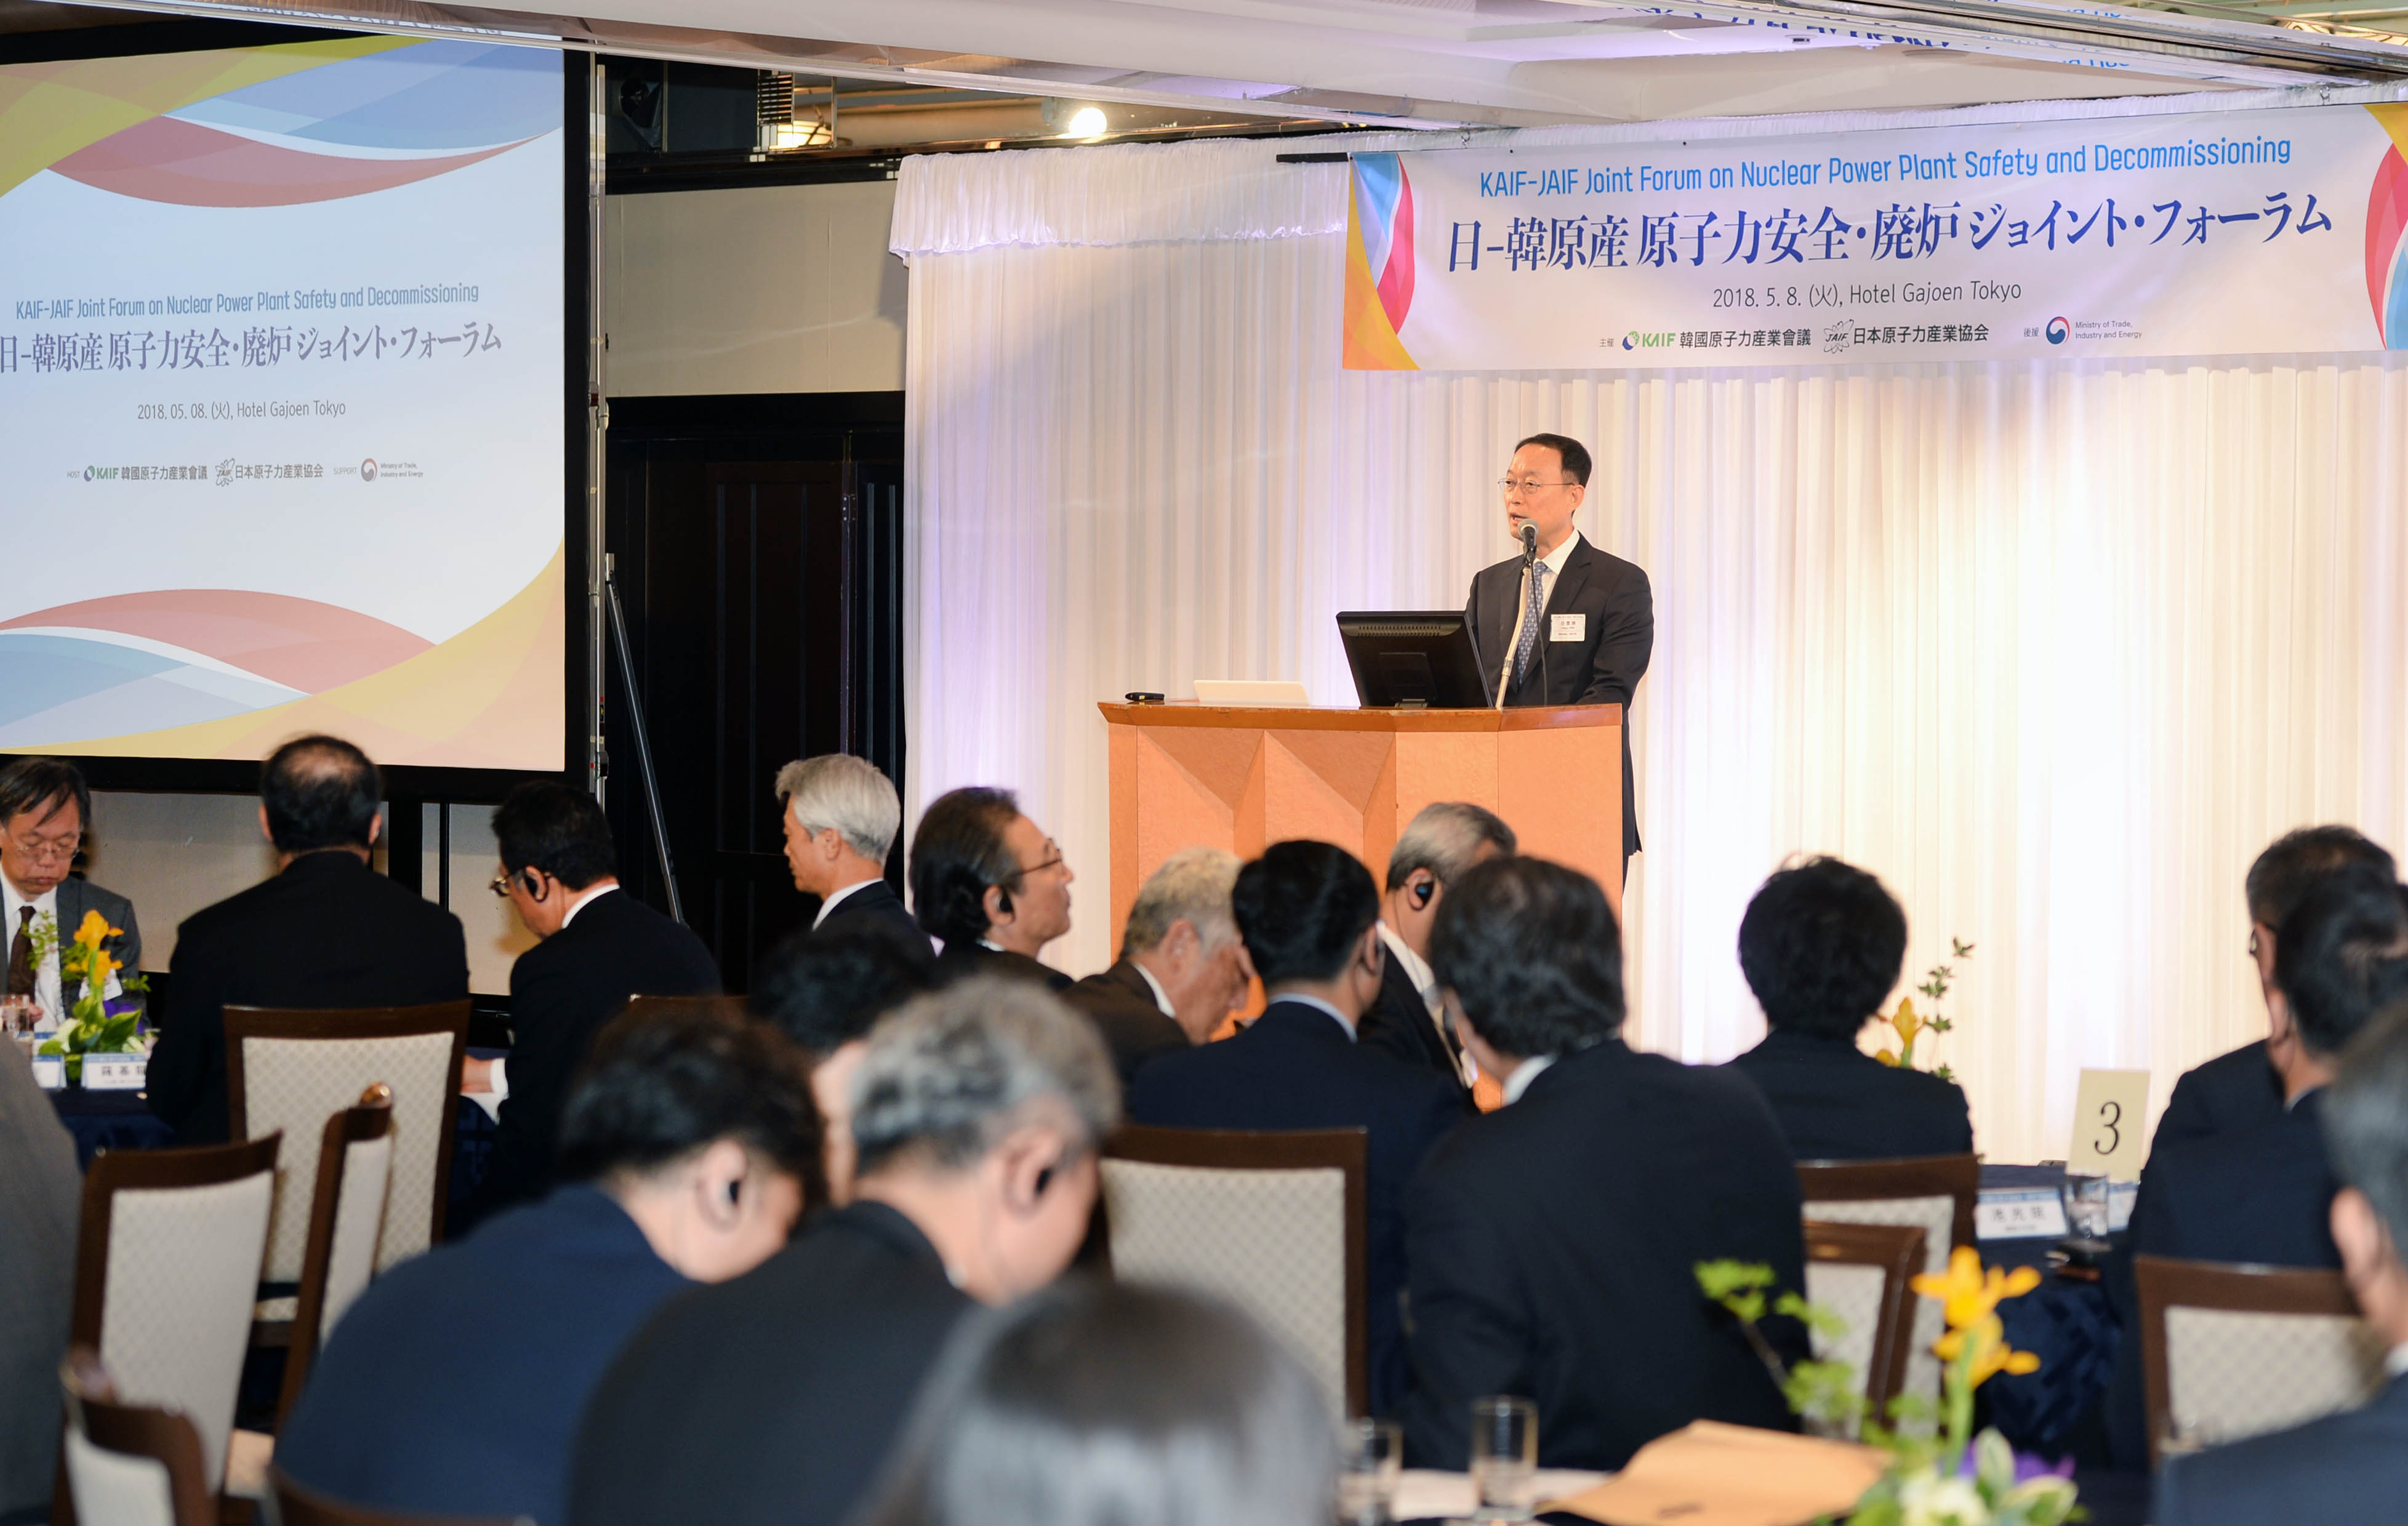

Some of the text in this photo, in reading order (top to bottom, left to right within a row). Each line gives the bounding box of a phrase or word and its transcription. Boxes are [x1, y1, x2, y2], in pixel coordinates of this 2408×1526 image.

[1480, 135, 2291, 197] KAIF-JAIF Joint Forum on Nuclear Power Plant Safety and Decommissioning
[16, 283, 479, 319] KAIF-JAIF Joint Forum on Nuclear Power Plant Safety and Decommissioning
[1713, 287, 1759, 307] 2018.
[1766, 287, 1780, 307] 5.
[1786, 286, 1801, 307] 8.
[1850, 284, 1895, 304] Hotel
[1903, 281, 1962, 305] Gajoen
[1970, 280, 2021, 303] Tokyo
[1642, 332, 1676, 347] KAIF
[1825, 323, 1989, 345] JAIF 日本原子力産業協会
[2119, 331, 2142, 339] Energy
[138, 404, 167, 419] 2018.
[171, 404, 187, 419] 05.
[191, 403, 207, 419] 08.
[237, 402, 266, 417] Hotel
[270, 401, 309, 419] Gajoen
[313, 400, 346, 418] Tokyo
[97, 467, 119, 480] KAIF
[2095, 1101, 2121, 1155] 3
